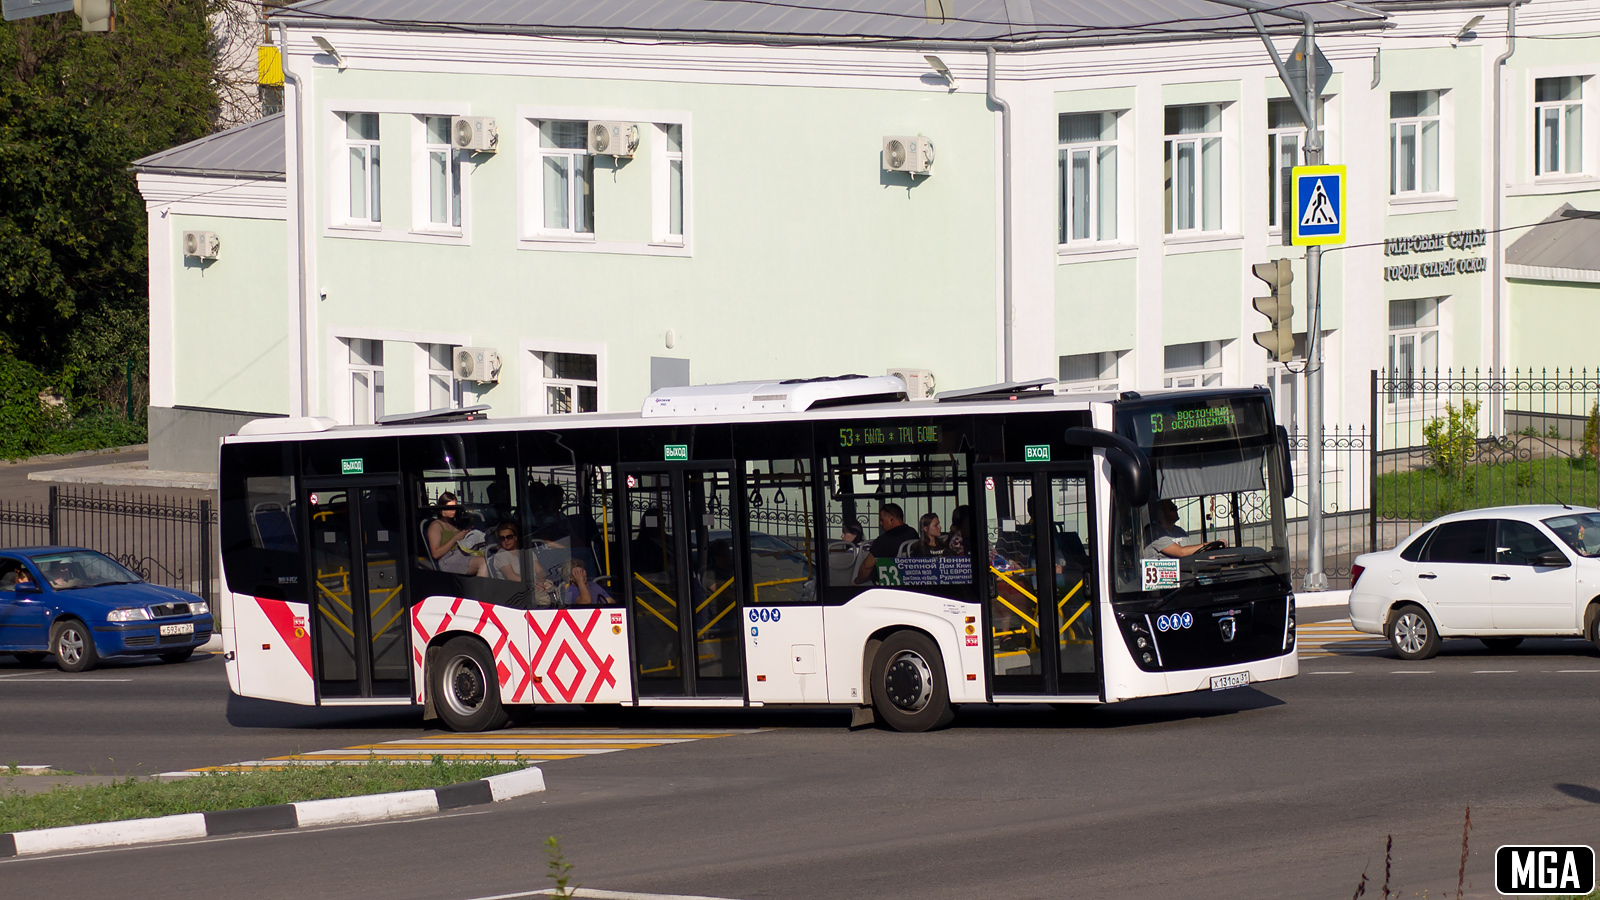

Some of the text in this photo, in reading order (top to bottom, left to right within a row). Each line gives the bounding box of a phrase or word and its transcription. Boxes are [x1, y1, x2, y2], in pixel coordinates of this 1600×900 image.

[1384, 264, 1420, 282] ГОРОДА
[1421, 258, 1456, 278] СТАРЫЙ
[1177, 406, 1229, 420] ВОСТОЧНЫЙ
[1150, 413, 1163, 433] 53
[1171, 414, 1235, 430] ОСКОЛЦЕМЕНТ
[840, 428, 853, 446] 53
[665, 447, 686, 458] ВЫХОД
[1027, 447, 1048, 458] ВХОД
[343, 461, 362, 471] ВЫХОД
[878, 566, 901, 586] 53
[1146, 568, 1158, 583] 53
